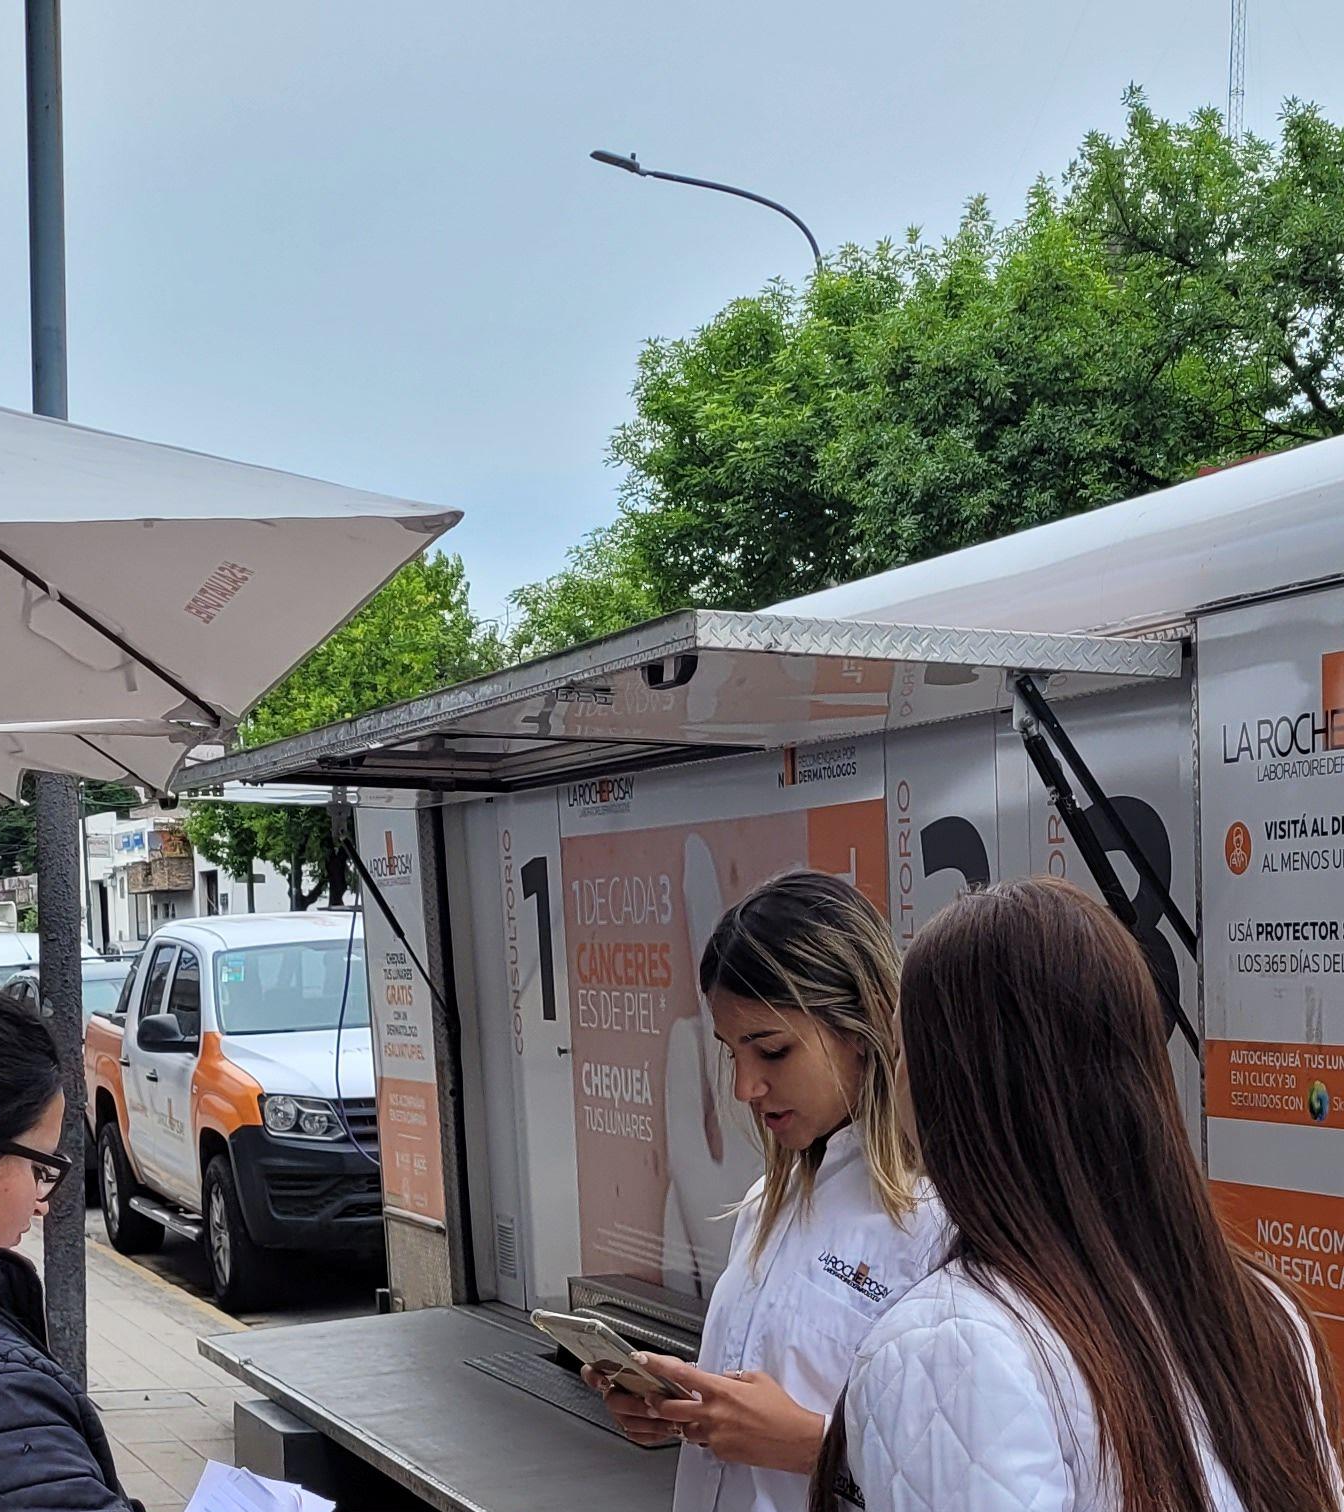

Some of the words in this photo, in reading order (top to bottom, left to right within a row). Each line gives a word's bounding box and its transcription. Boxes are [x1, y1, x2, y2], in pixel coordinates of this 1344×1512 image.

[1222, 722, 1255, 764] LA
[1257, 759, 1326, 783] LABORATOIRE
[1265, 813, 1308, 841] VISITÁ
[1311, 817, 1329, 837] AL
[1261, 853, 1278, 873] AL
[1281, 849, 1330, 872] MENOS
[571, 880, 582, 925] 1
[583, 879, 608, 925] DE
[608, 875, 659, 925] CADA
[659, 873, 672, 925] 3
[502, 829, 524, 1056] CONSULTORIO
[1228, 917, 1254, 943] USÁ
[1256, 920, 1340, 942] PROTECTOR
[576, 931, 673, 988] CÁNCERES
[1237, 953, 1262, 973] LOS
[1264, 953, 1287, 973] 365
[1289, 948, 1320, 974] DÍAS
[578, 989, 598, 1028] ES
[600, 991, 622, 1031] DE
[1230, 1050, 1301, 1070] AUTOCHEQUEÁ
[1304, 1053, 1325, 1069] TUS
[582, 1060, 654, 1109] CHEQUEÁ
[1231, 1070, 1244, 1085] EN
[1250, 1072, 1277, 1088] CLICK
[1285, 1074, 1296, 1089] 30
[1231, 1091, 1282, 1111] SEGUNDOS
[1282, 1095, 1304, 1112] CON
[583, 1105, 604, 1132] TUS
[604, 1109, 653, 1143] LUNARES
[1257, 1217, 1294, 1248] NOS
[1280, 1254, 1325, 1288] ESTA
